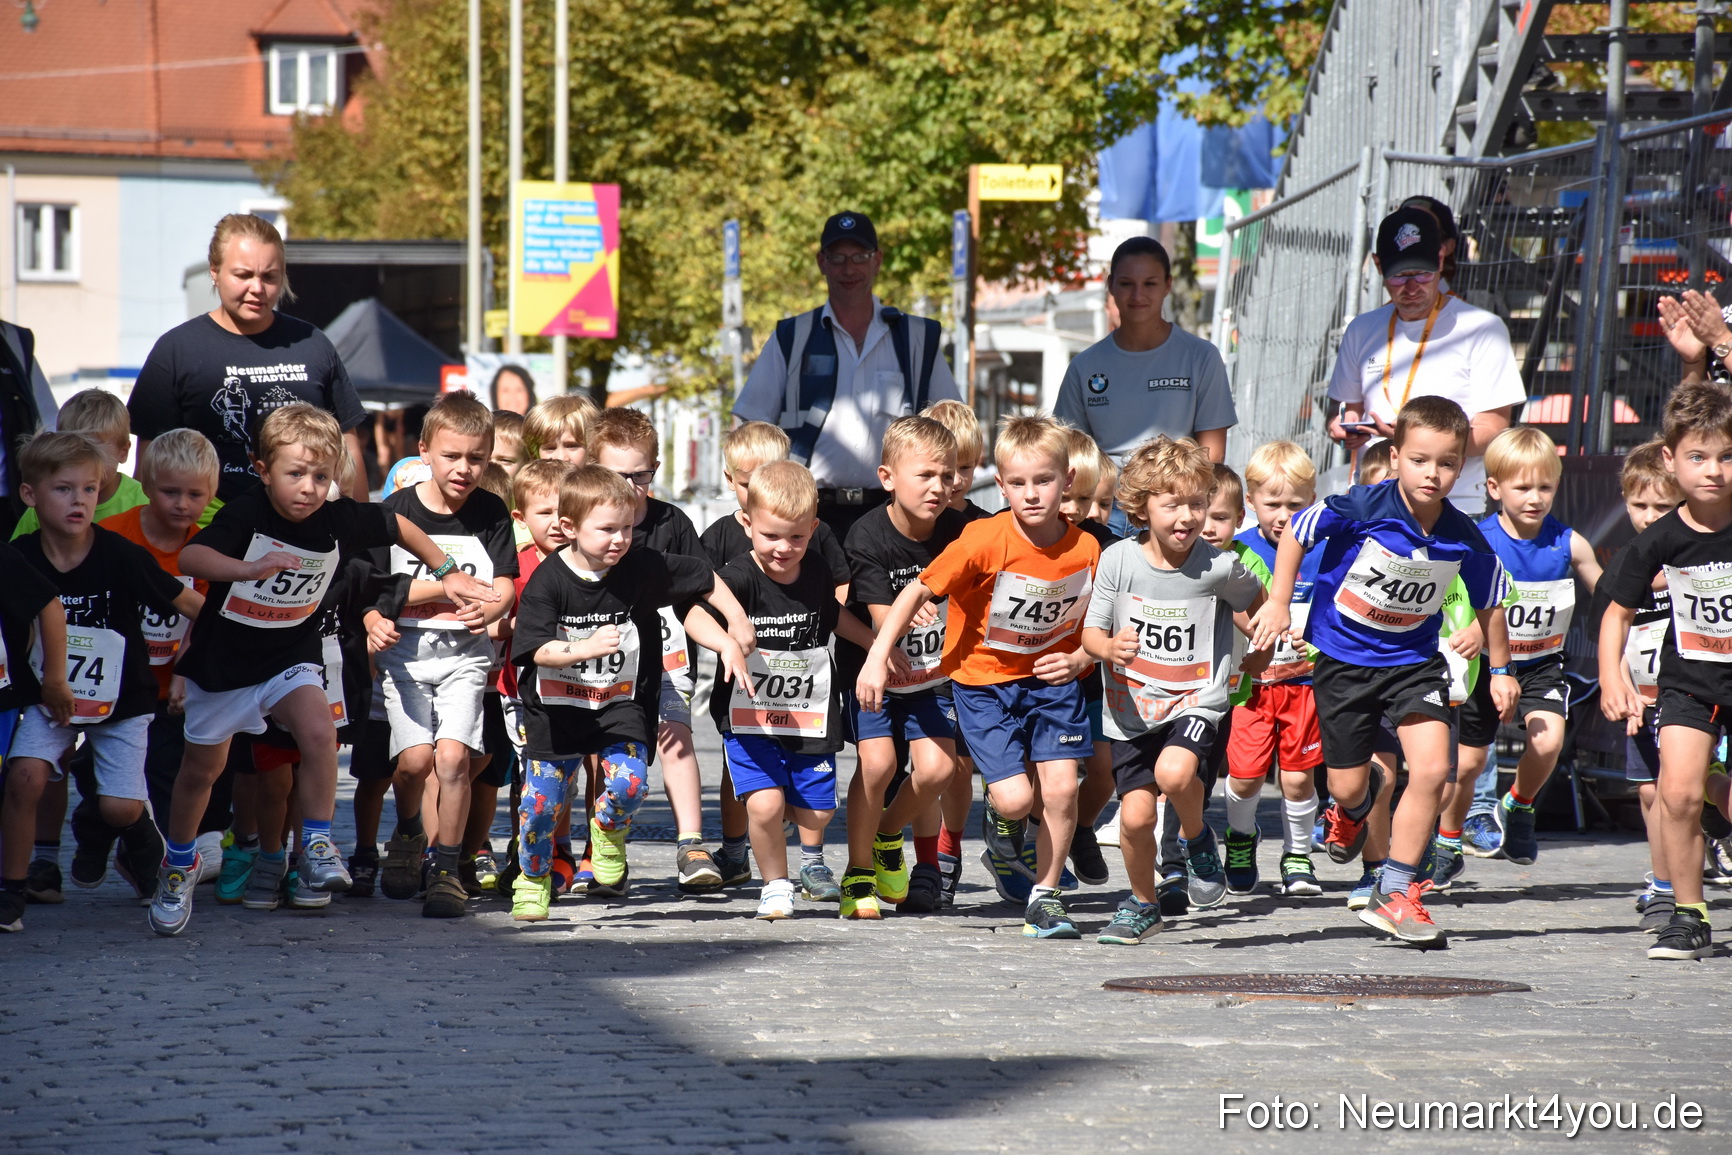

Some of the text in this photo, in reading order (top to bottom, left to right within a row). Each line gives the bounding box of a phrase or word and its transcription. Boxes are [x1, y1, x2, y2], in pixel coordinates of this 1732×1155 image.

[981, 175, 1046, 189] Toiletten
[225, 363, 306, 376] Neumarkter
[250, 373, 308, 383] STADTLAUF
[1148, 377, 1191, 388] BOCK
[1387, 560, 1433, 576] BOCK
[1024, 583, 1068, 596] BOCK
[1364, 566, 1436, 604] 7400
[253, 592, 275, 604] PARTL
[1362, 590, 1414, 612] PARTL Neumarkt
[246, 605, 292, 620] Lukas
[1008, 596, 1079, 624] 7437
[1142, 604, 1188, 618] BOCK
[1366, 607, 1404, 625] Anton
[1508, 604, 1556, 630] 041
[1010, 622, 1032, 631] PARTL
[1696, 624, 1716, 634] PARTL
[1018, 632, 1054, 646] Fabian
[1129, 616, 1196, 652] 7561
[1510, 642, 1544, 652] arkuss
[1137, 648, 1186, 663] ARTL Neumarkt
[768, 658, 808, 669] BOCK
[559, 674, 580, 682] PARTL
[566, 684, 610, 700] Bastian
[751, 672, 814, 700] 7031
[1105, 688, 1128, 712] BE
[766, 712, 789, 725] Karl
[1184, 716, 1206, 742] 10
